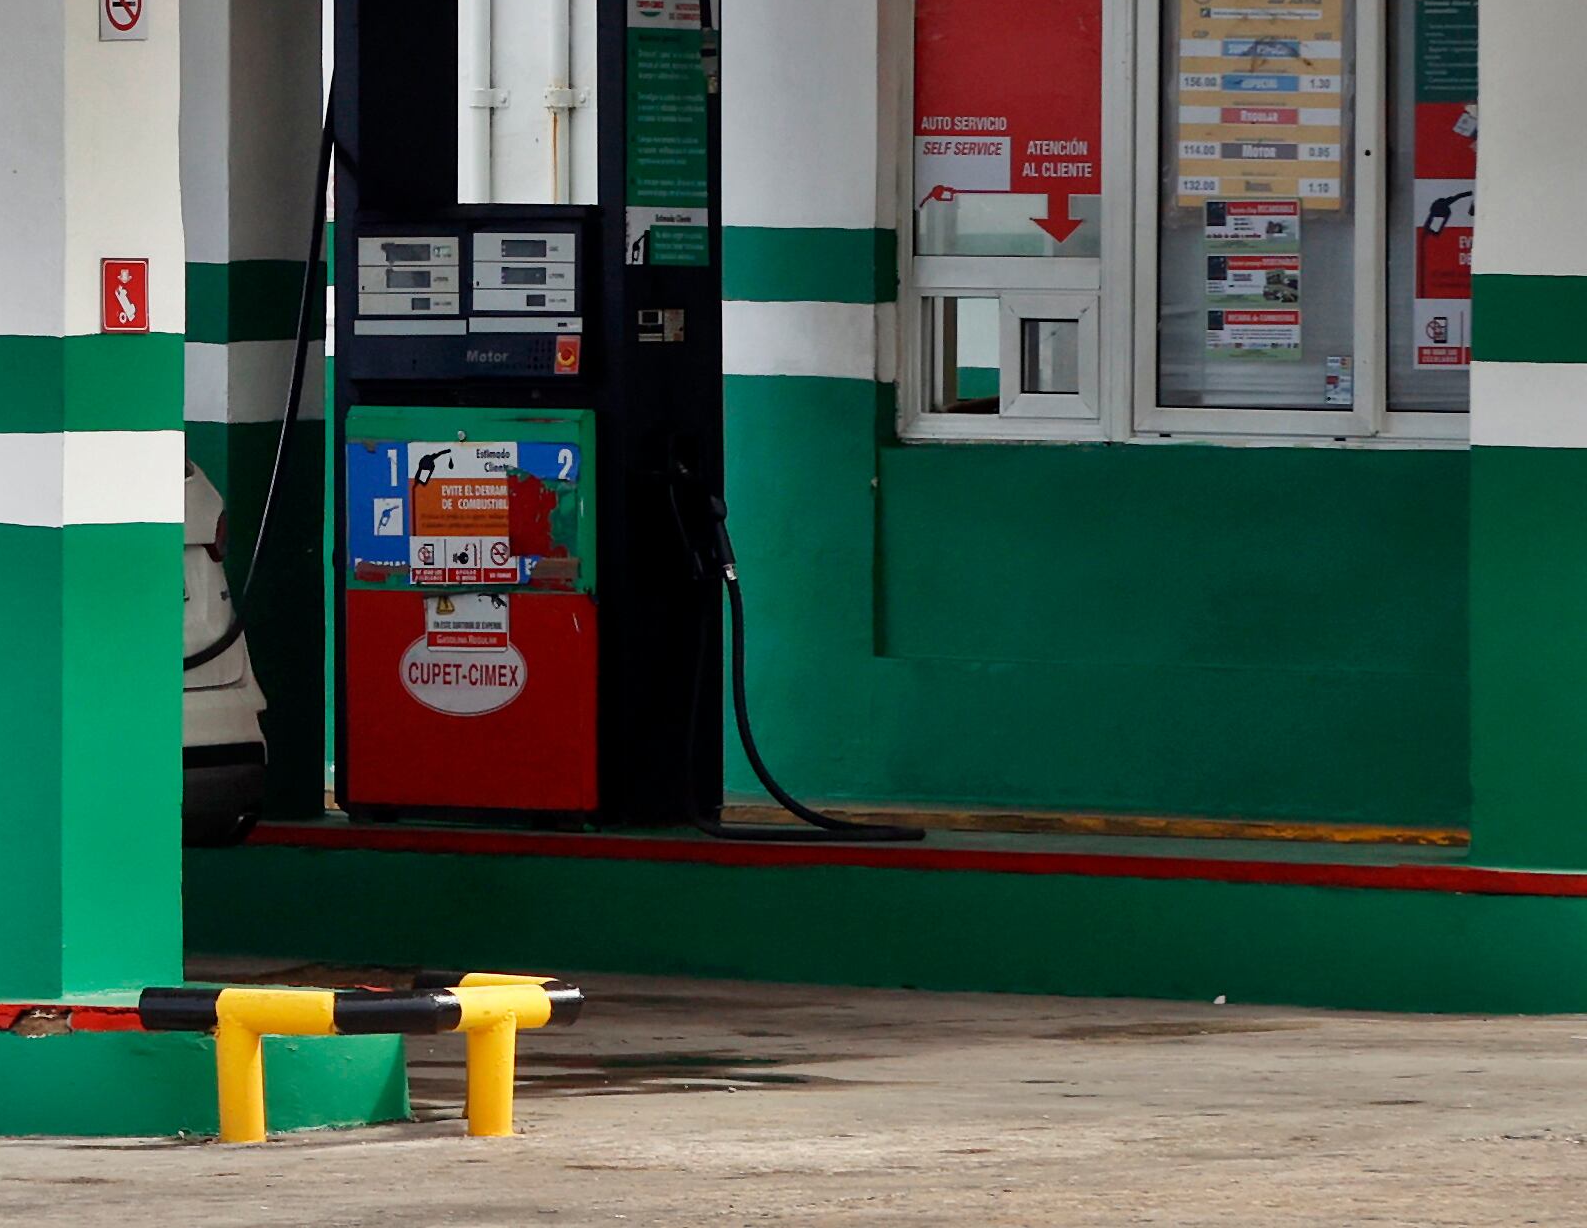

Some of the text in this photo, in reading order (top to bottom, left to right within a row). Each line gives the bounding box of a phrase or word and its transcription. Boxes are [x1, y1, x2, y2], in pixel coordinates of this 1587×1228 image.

[921, 116, 1007, 131] AUTO SERVICIO
[923, 141, 1003, 156] SELF SERVICE
[1027, 137, 1088, 155] ATENCIÓN
[1022, 162, 1092, 178] AL CLIENTE
[466, 349, 509, 362] Motor
[476, 449, 510, 459] Estimado
[387, 449, 398, 486] 1
[558, 449, 573, 480] 2
[442, 485, 463, 496] EVITE
[465, 485, 474, 496] EL
[442, 499, 453, 510] DE
[408, 662, 519, 687] CUPET-CIMEX
